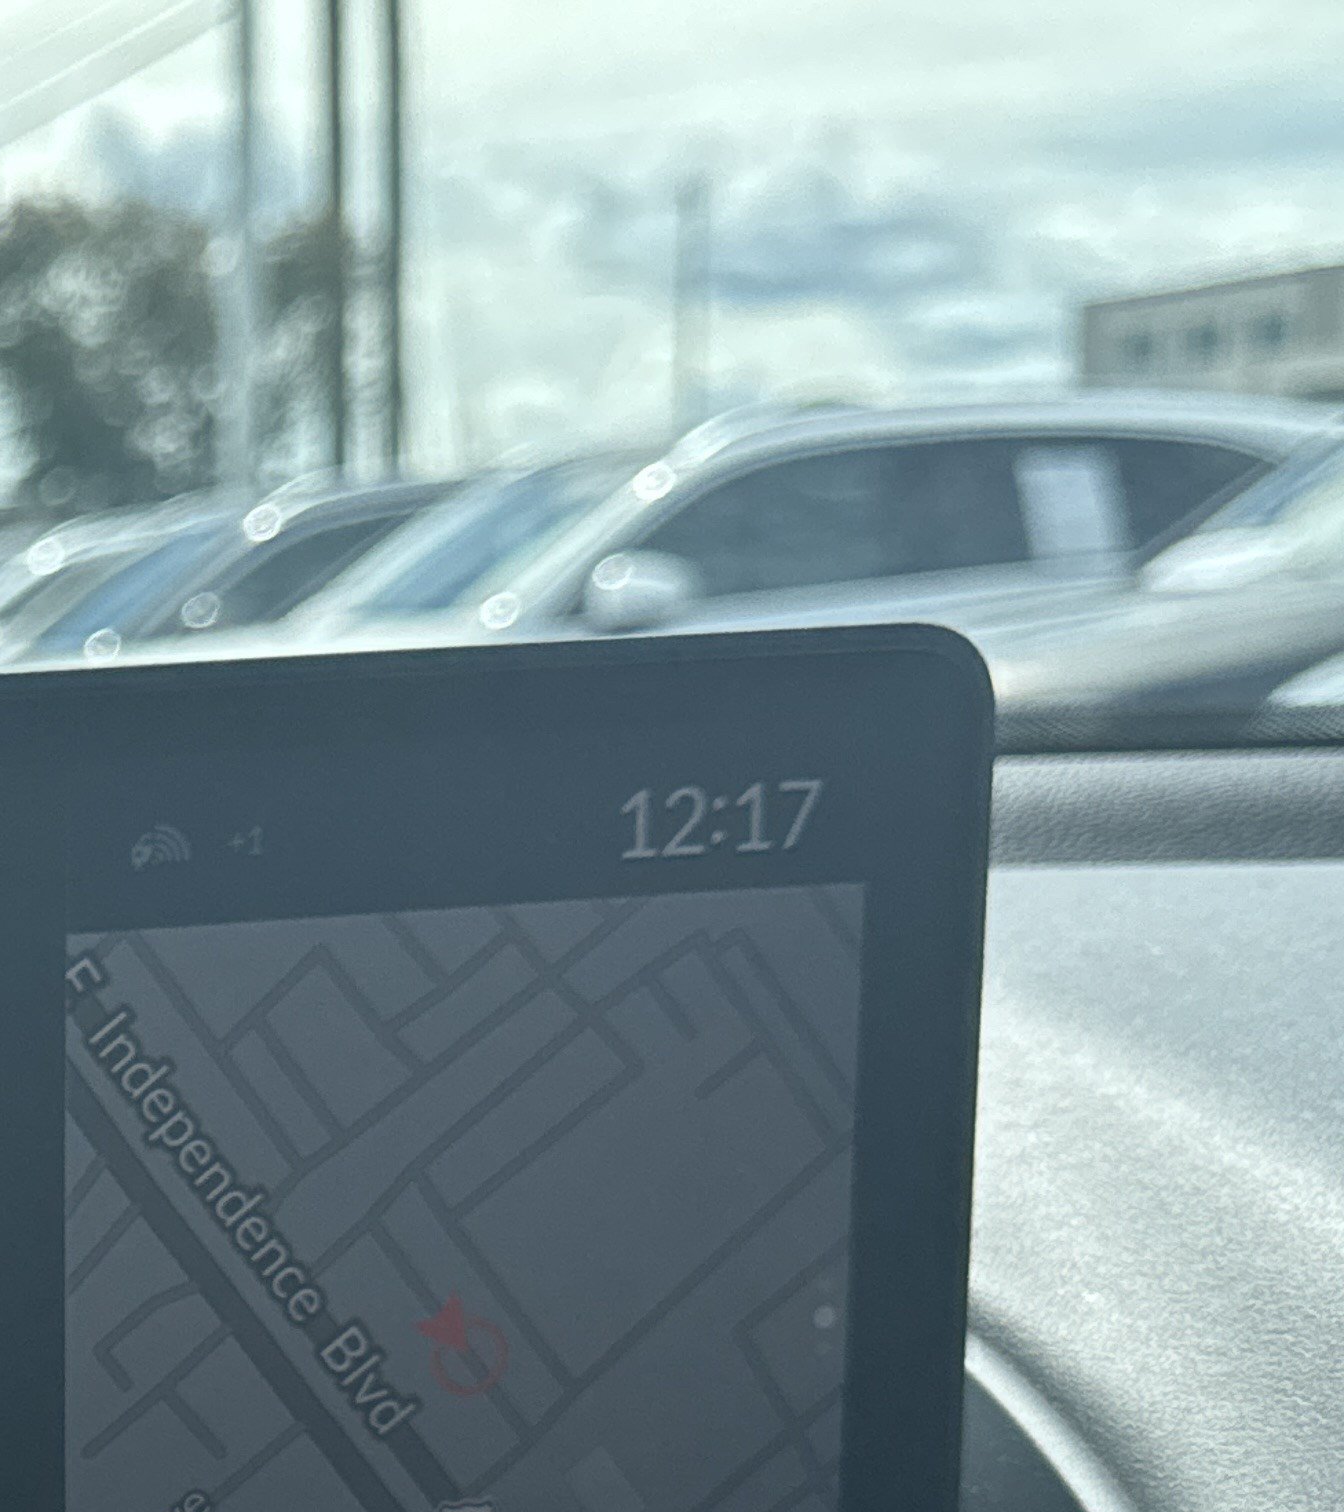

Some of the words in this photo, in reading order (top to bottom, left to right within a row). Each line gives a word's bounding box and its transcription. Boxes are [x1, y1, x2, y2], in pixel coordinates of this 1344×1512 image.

[619, 779, 824, 861] 12:17
[88, 1010, 322, 1322] Independence
[319, 1325, 418, 1435] Blvd
